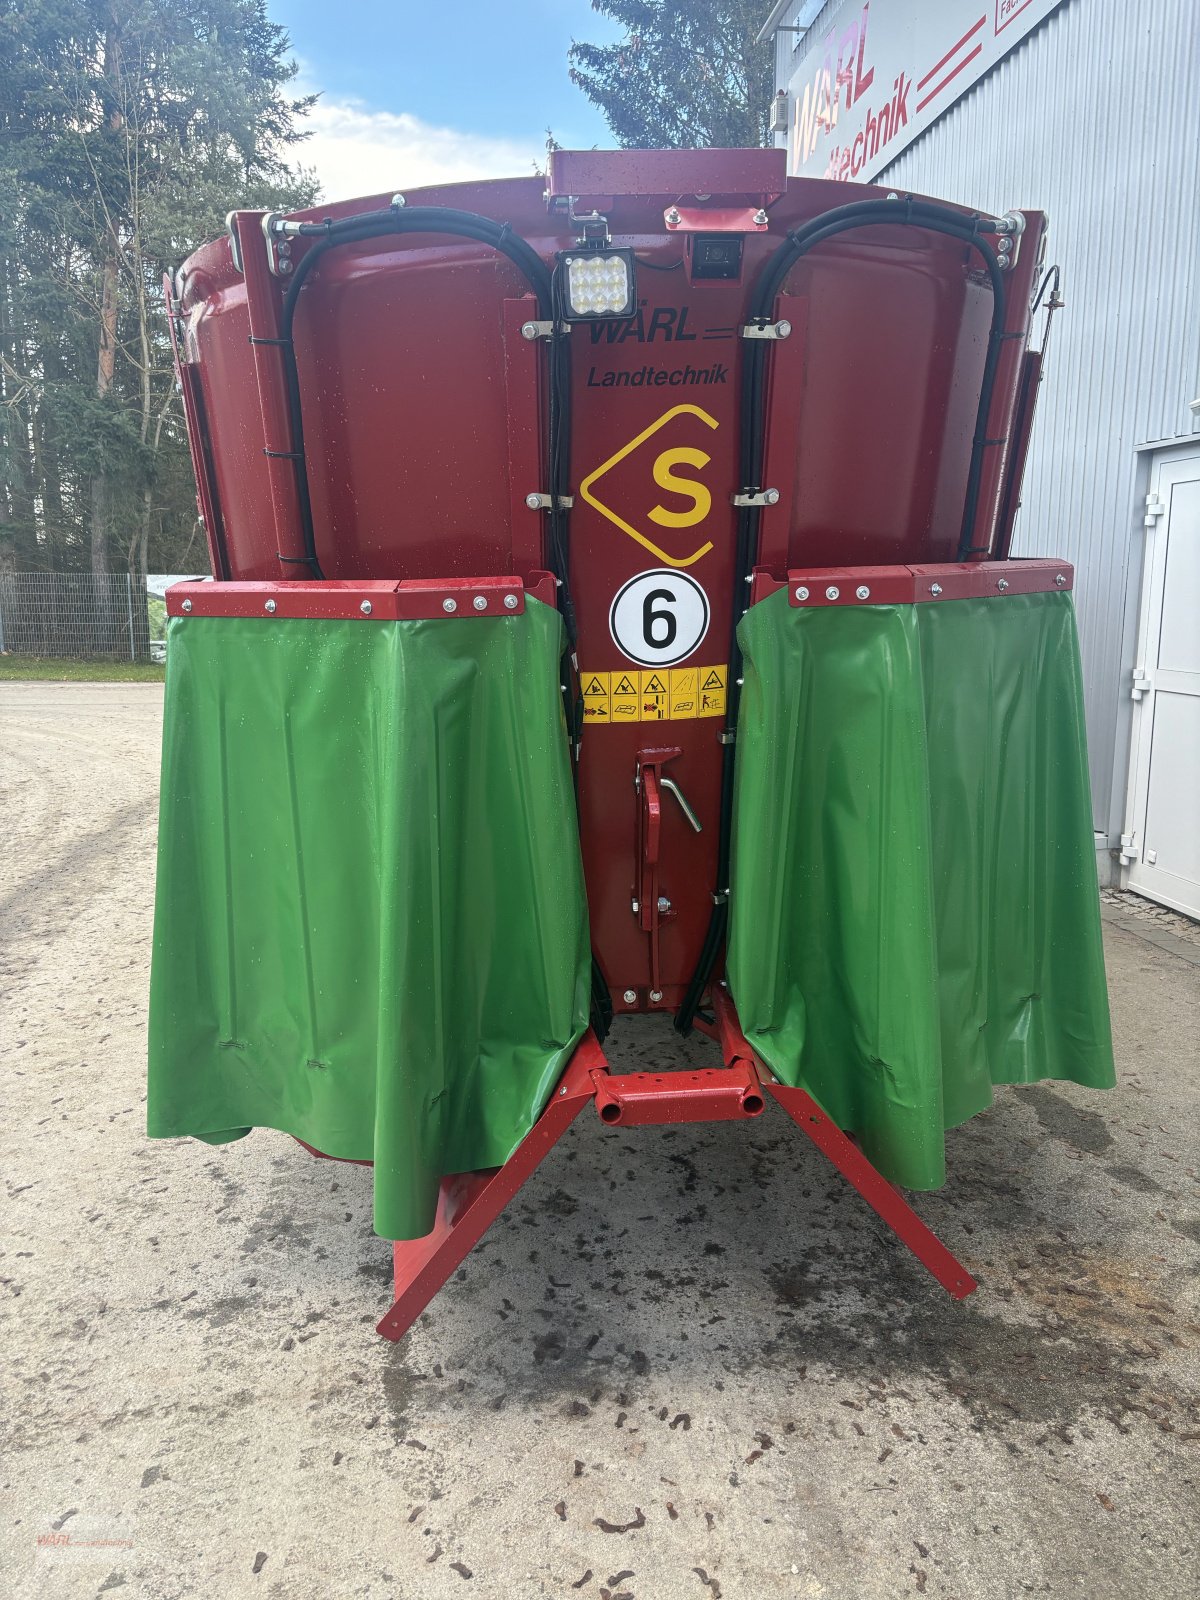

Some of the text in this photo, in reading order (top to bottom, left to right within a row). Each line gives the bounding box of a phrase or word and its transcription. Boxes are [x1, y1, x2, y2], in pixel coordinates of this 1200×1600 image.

[1000, 0, 1018, 19] Fac
[587, 363, 729, 387] Landtechnik
[647, 447, 712, 528] S
[642, 588, 677, 650] 6
